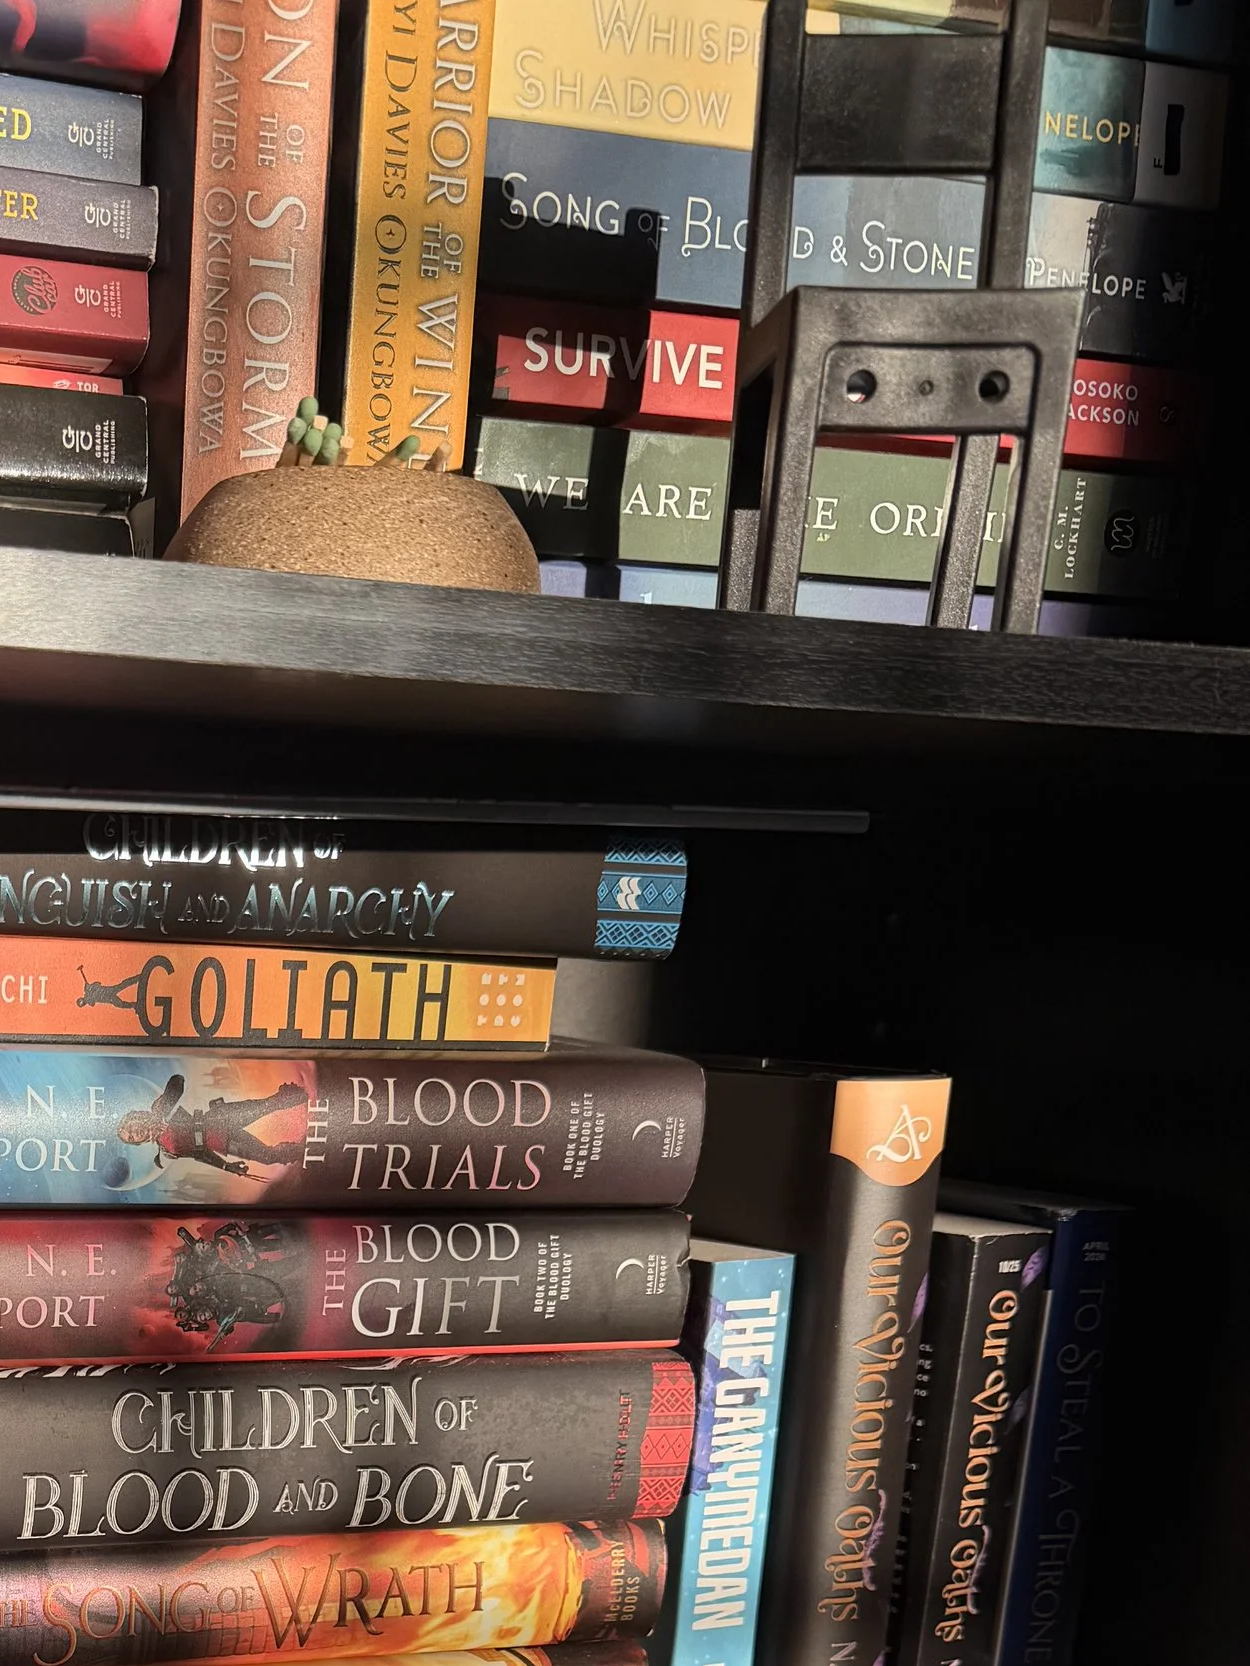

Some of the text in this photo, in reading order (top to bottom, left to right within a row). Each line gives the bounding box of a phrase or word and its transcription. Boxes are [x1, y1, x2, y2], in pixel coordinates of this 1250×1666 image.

[515, 48, 732, 129] SHADOW
[95, 121, 103, 153] GRAND
[102, 118, 110, 159] CENTRAL
[257, 111, 306, 168] OF THE
[380, 49, 419, 201] DAVIES
[498, 171, 976, 281] SONG STONE
[1025, 256, 1147, 300] PENELOPE
[196, 184, 237, 456] OKUNGBOWA
[238, 188, 307, 461] STORM
[522, 326, 725, 391] SURVIVE
[76, 380, 100, 393] TOR
[94, 423, 102, 459] GRAND
[102, 419, 110, 464] CENTRAL
[514, 472, 714, 522] WE ARE
[1054, 503, 1069, 527] M.
[1063, 476, 1088, 581] LOCKHART
[227, 876, 456, 941] ANARCHY
[136, 954, 451, 1041] GOLIATH
[348, 1076, 552, 1128] BLOOD
[562, 1143, 577, 1171] BOOK
[578, 1121, 592, 1156] BLOOD
[590, 1112, 605, 1161] DUOLOGY
[661, 1116, 674, 1158] HARPER
[342, 1143, 546, 1191] TRIALS
[352, 1222, 521, 1265] BLOOD
[534, 1284, 546, 1313] BOOK
[548, 1262, 559, 1297] BLOOD
[560, 1252, 573, 1301] DUOLOGY
[645, 1254, 656, 1295] HARPER
[656, 1254, 667, 1295] Voyager
[351, 1274, 521, 1338] GIFT
[111, 1375, 479, 1460] CHILDREN OF
[844, 1311, 906, 1494] Vicious
[957, 1289, 1019, 1531] Our Vicious
[16, 1452, 536, 1542] BLOOD AND BONE
[1023, 1342, 1104, 1665] STEAL THRONE
[251, 1551, 485, 1651] WRATH
[620, 1575, 641, 1622] BOOKS
